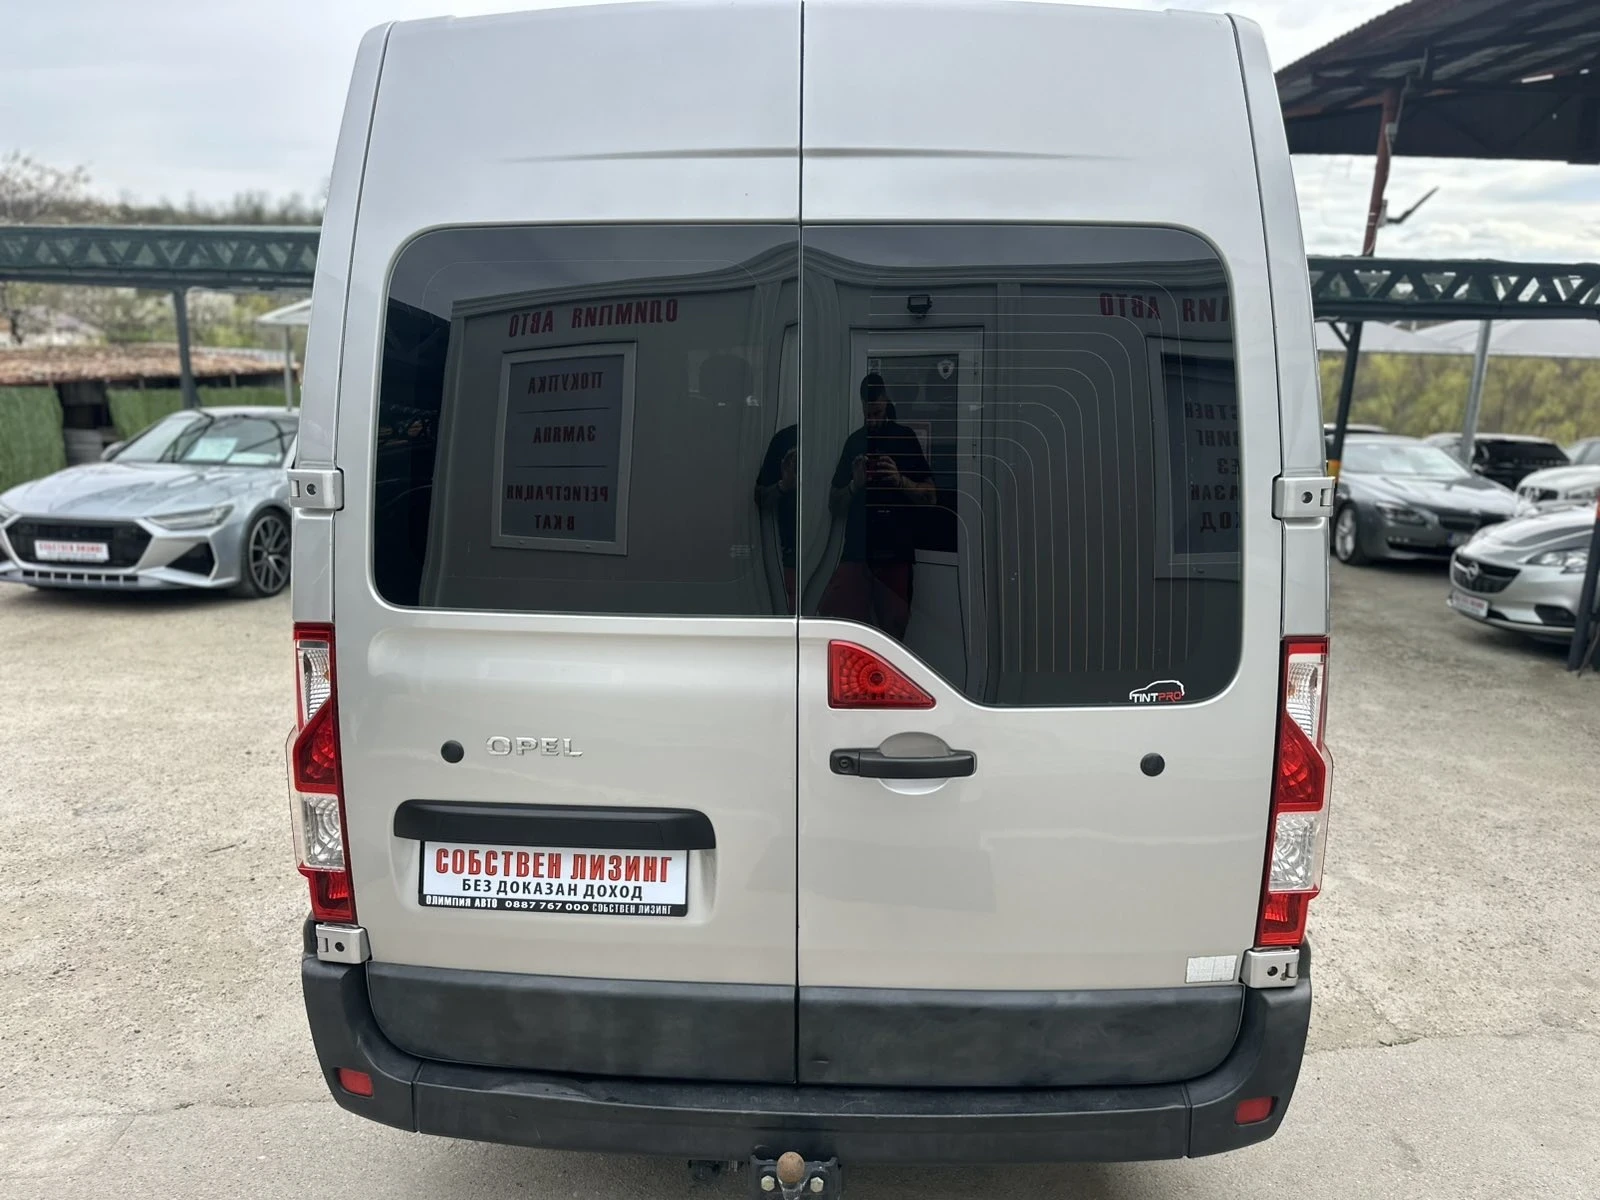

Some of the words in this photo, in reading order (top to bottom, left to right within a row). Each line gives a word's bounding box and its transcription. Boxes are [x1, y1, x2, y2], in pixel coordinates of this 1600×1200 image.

[485, 735, 584, 757] OPEL
[435, 848, 562, 879] СОБСТВЕН
[570, 853, 673, 882] ЛИЗИНГ
[462, 878, 492, 893] БЕЗ
[496, 880, 578, 897] ДОКАЗАН
[583, 883, 643, 901] ДОХОД
[425, 895, 471, 907] ОЛИМПИЯ
[474, 898, 498, 909] АВТО
[505, 900, 536, 909] 0887
[539, 902, 562, 910] 767
[565, 903, 589, 911] 000
[592, 903, 636, 914] СОБСТВЕН
[638, 905, 672, 915] ЛИЗИНГ
